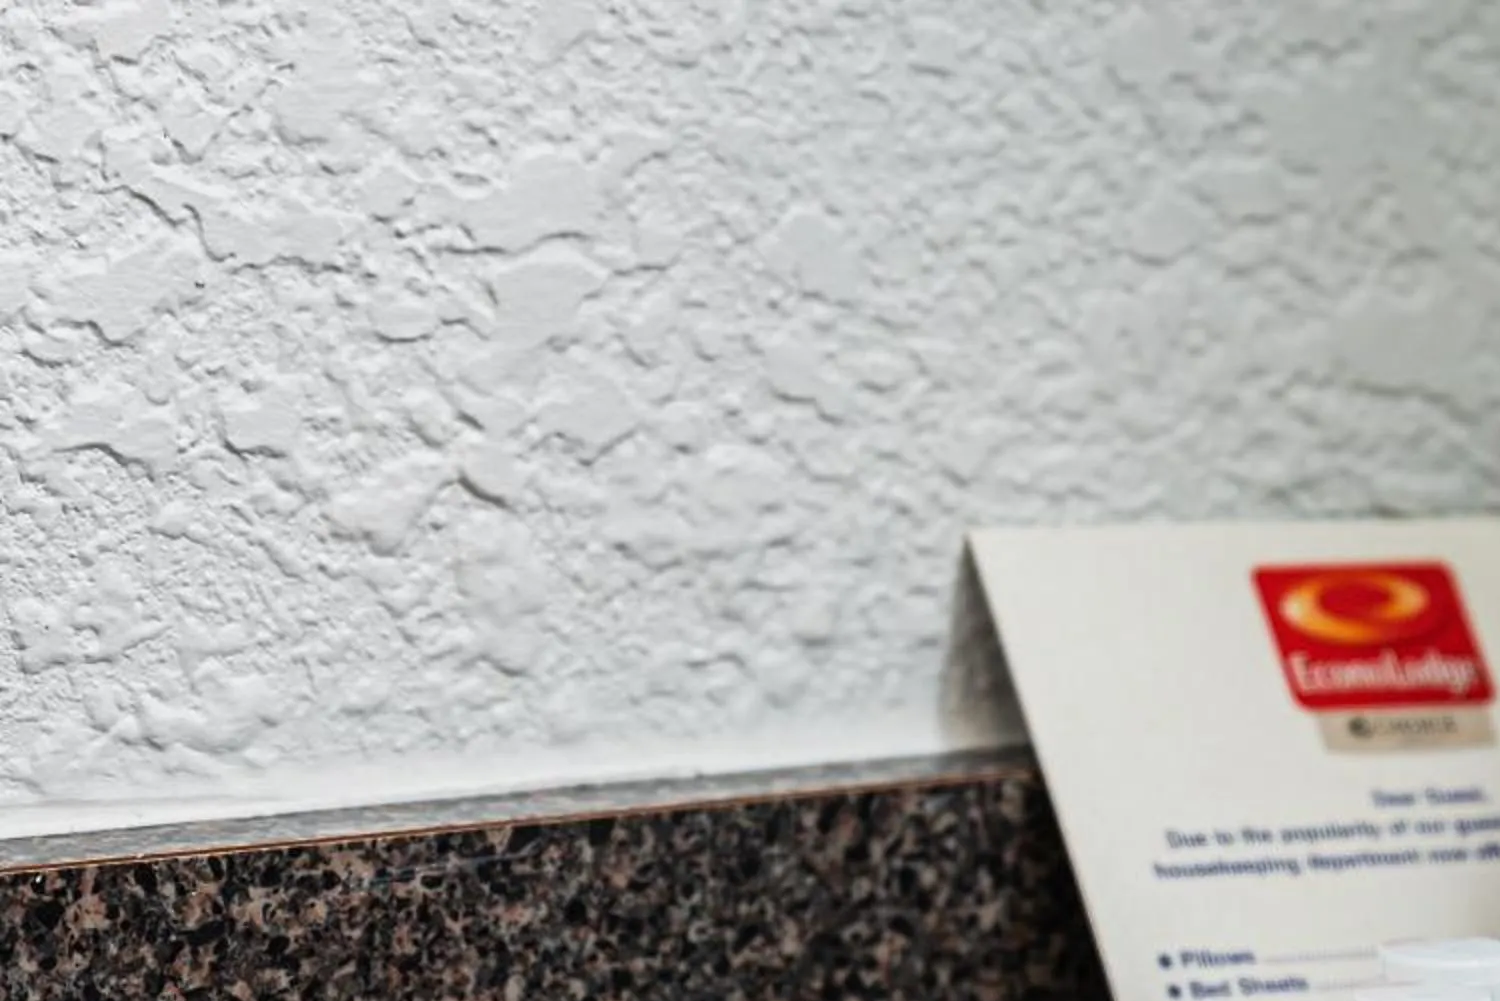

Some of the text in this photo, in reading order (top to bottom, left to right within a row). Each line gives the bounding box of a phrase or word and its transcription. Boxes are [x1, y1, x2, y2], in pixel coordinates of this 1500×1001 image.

[1165, 830, 1207, 849] Due
[1213, 828, 1234, 844] to
[1241, 827, 1273, 843] the
[1152, 854, 1301, 878] housekeeping
[1306, 848, 1419, 871] department
[1428, 849, 1468, 864] now
[1179, 951, 1255, 968] Pillows
[1189, 977, 1309, 998] Bed Sheets
